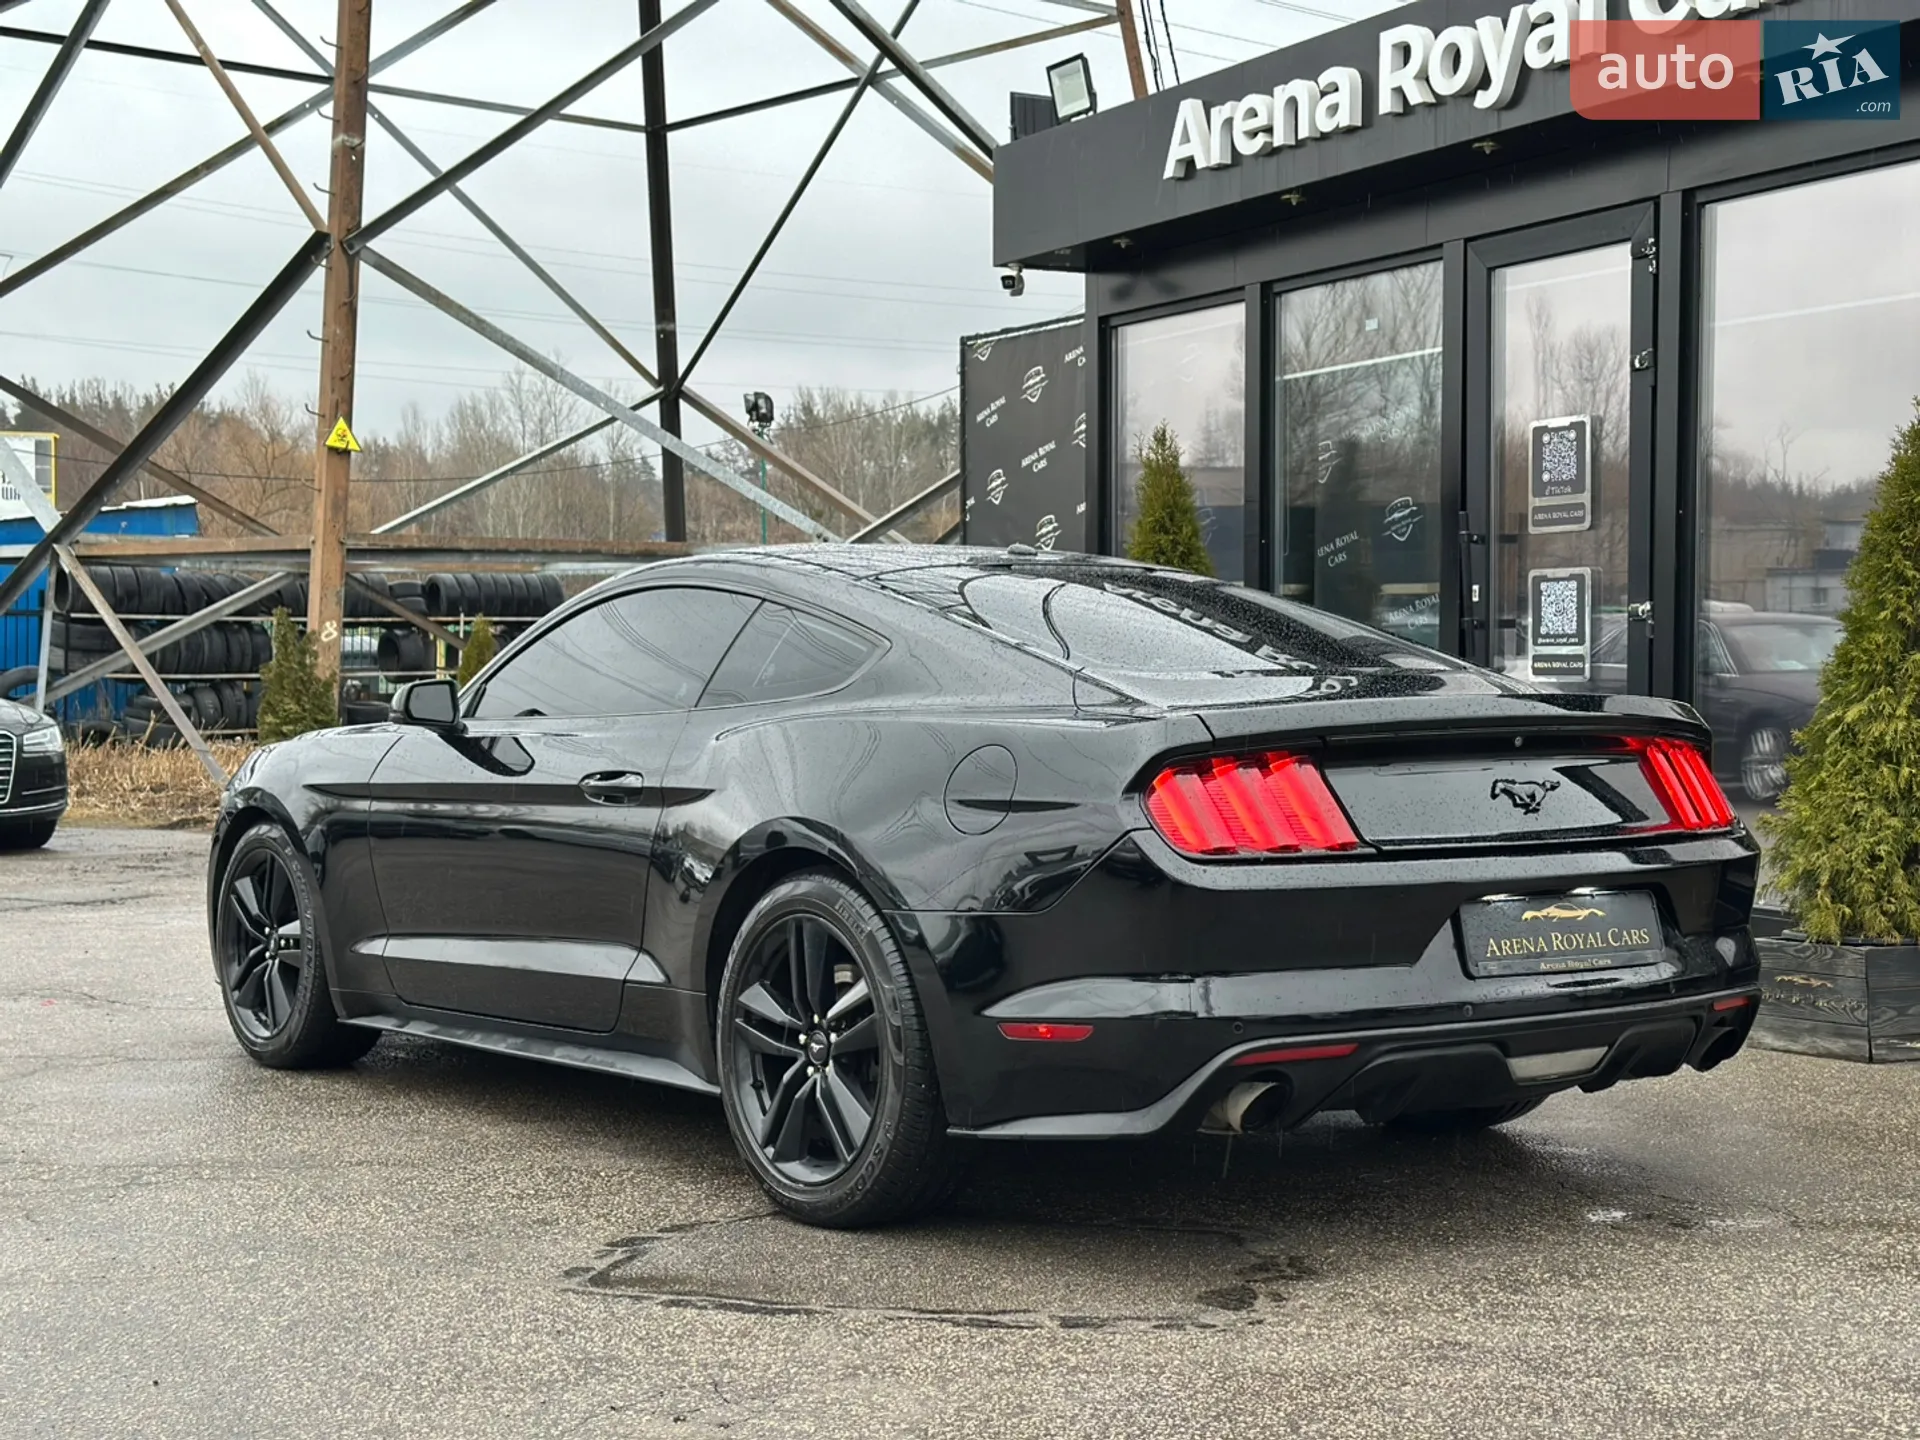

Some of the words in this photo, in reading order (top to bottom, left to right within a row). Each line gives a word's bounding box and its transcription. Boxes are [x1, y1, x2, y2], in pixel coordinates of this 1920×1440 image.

[1163, 66, 1363, 180] Arena
[1378, 0, 1607, 114] Royal
[1335, 530, 1359, 549] ROYAL
[1327, 551, 1347, 567] CARS
[1486, 936, 1548, 957] ARENA
[1551, 932, 1606, 951] ROYAL
[1607, 928, 1650, 947] CARS
[1540, 961, 1566, 970] Arena
[1567, 959, 1591, 969] Royal
[1592, 957, 1612, 966] Cars
